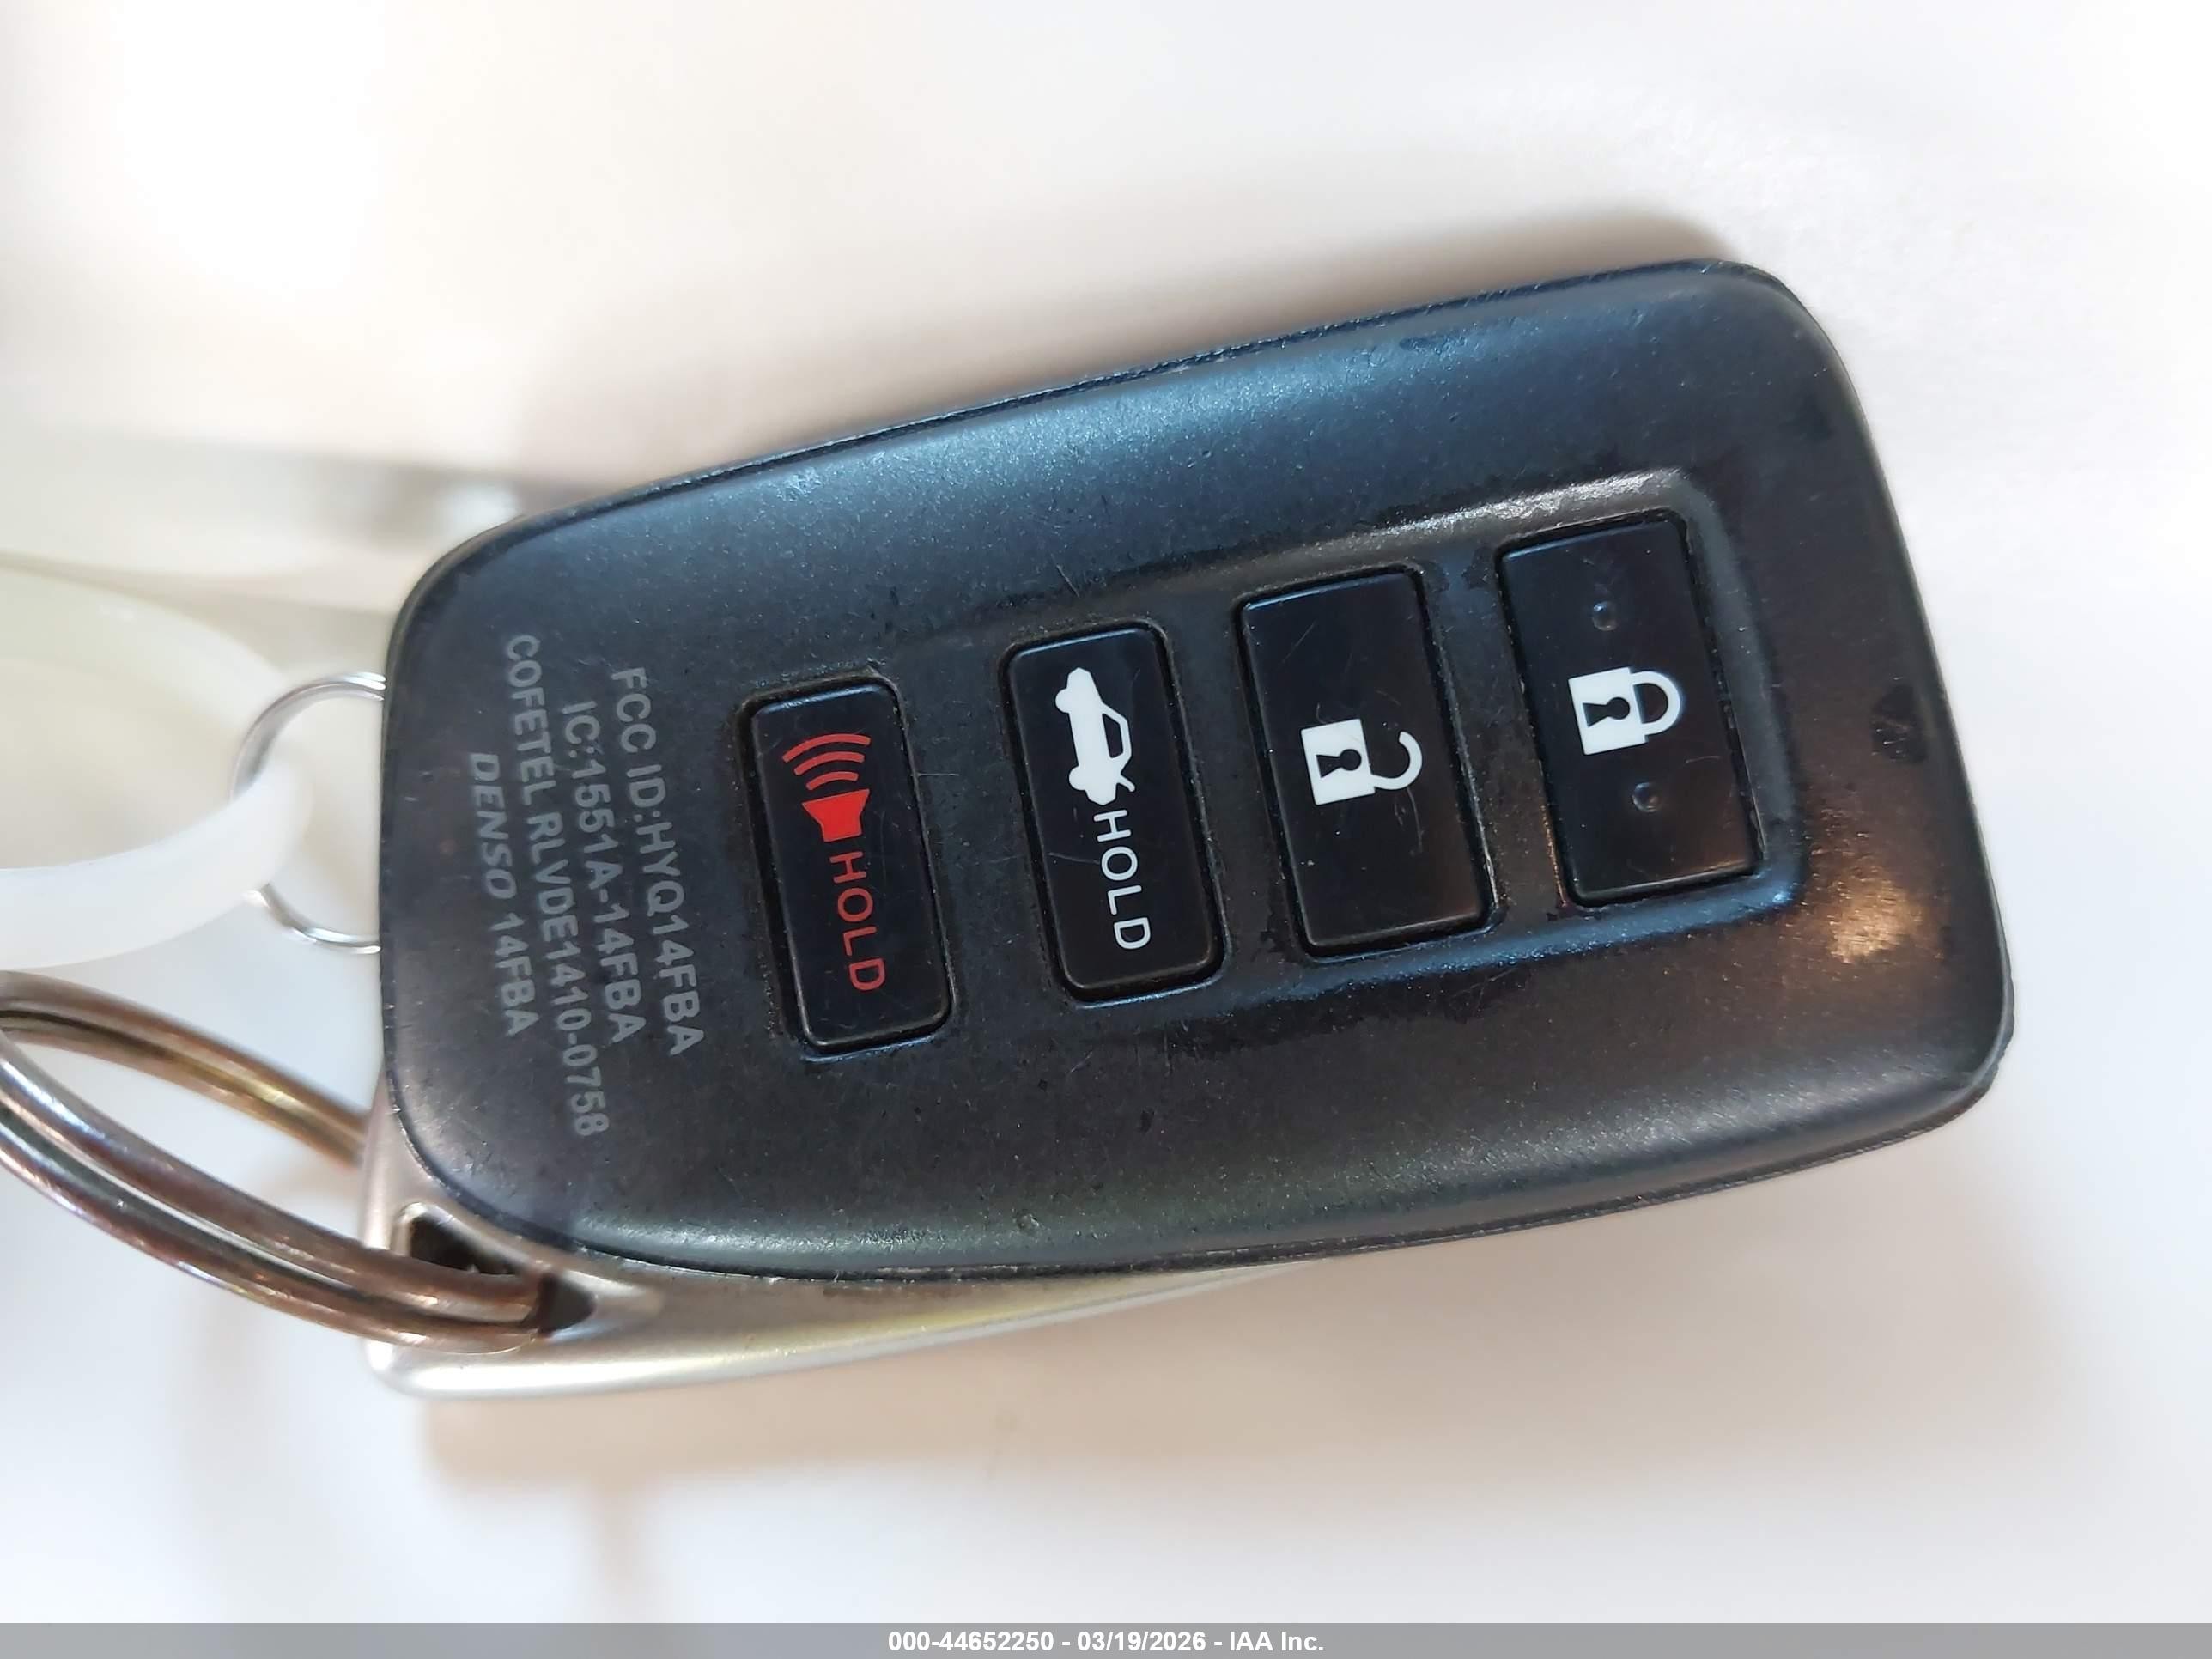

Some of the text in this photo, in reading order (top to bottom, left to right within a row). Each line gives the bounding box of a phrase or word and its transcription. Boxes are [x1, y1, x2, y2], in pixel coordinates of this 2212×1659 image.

[470, 752, 539, 1036] DENSO 14FBA
[507, 635, 610, 1136] COFETEL RLVDE1410-0758
[562, 701, 646, 1042] IC:1551A-14FBA
[611, 667, 704, 1055] FCC ID:HYQ14FBA
[830, 851, 885, 991] HOLD
[1093, 809, 1151, 950] HOLD
